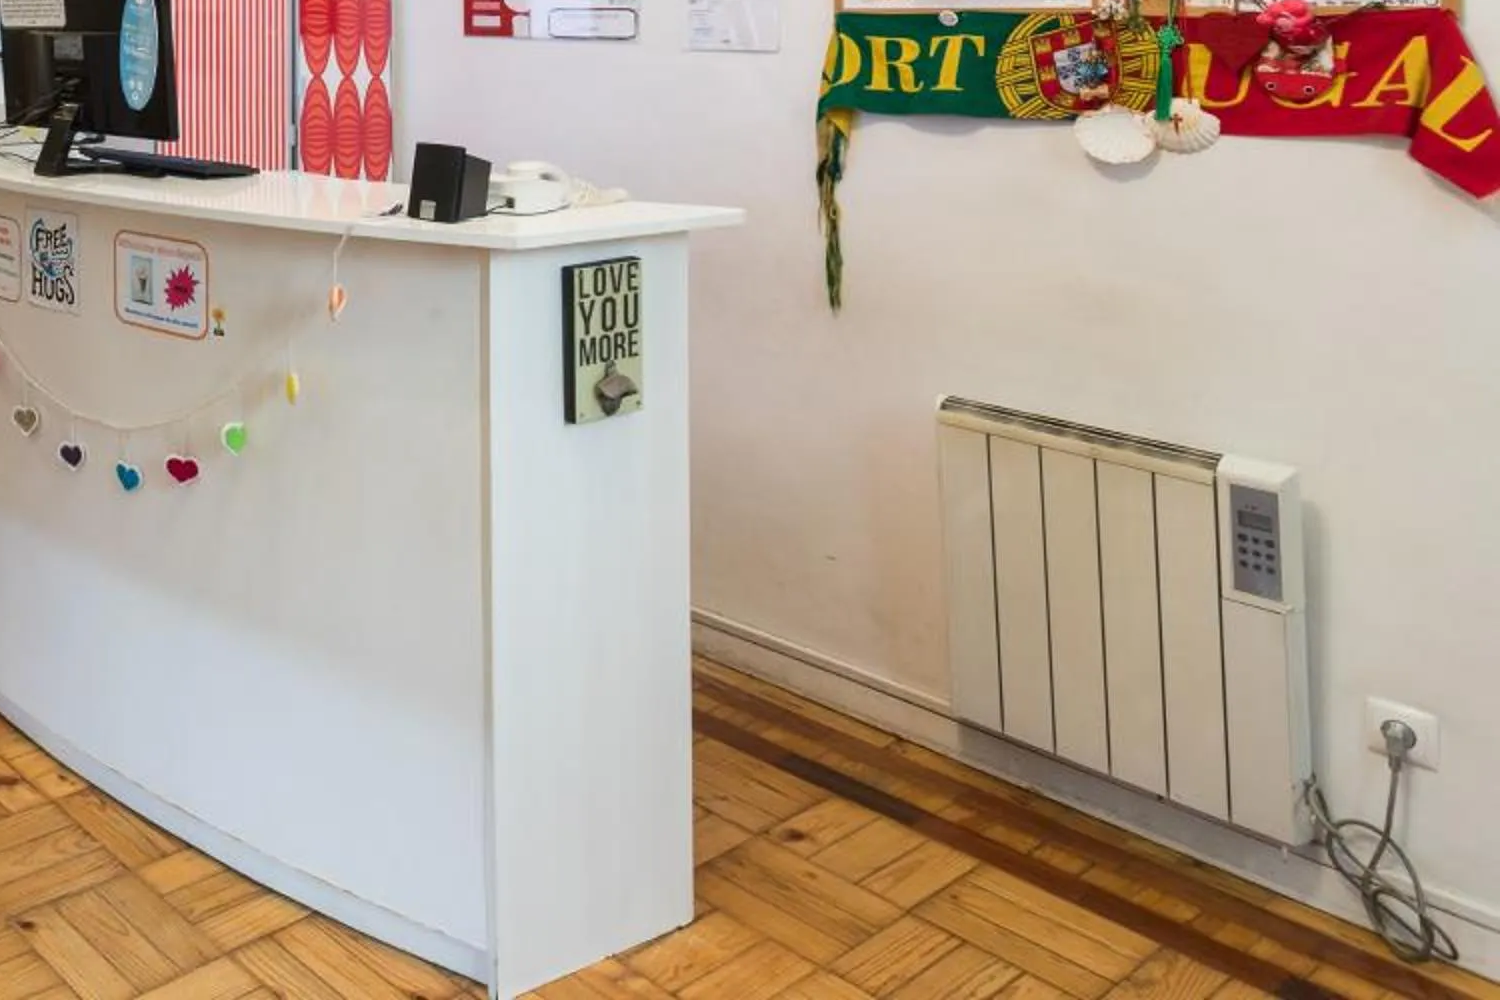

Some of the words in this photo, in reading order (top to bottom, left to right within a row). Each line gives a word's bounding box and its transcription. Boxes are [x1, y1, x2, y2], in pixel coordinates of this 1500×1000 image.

[34, 223, 68, 252] FREE
[30, 262, 76, 306] HUGS
[578, 261, 640, 300] LOVE
[578, 291, 640, 336] YOU
[578, 329, 640, 367] MORE
